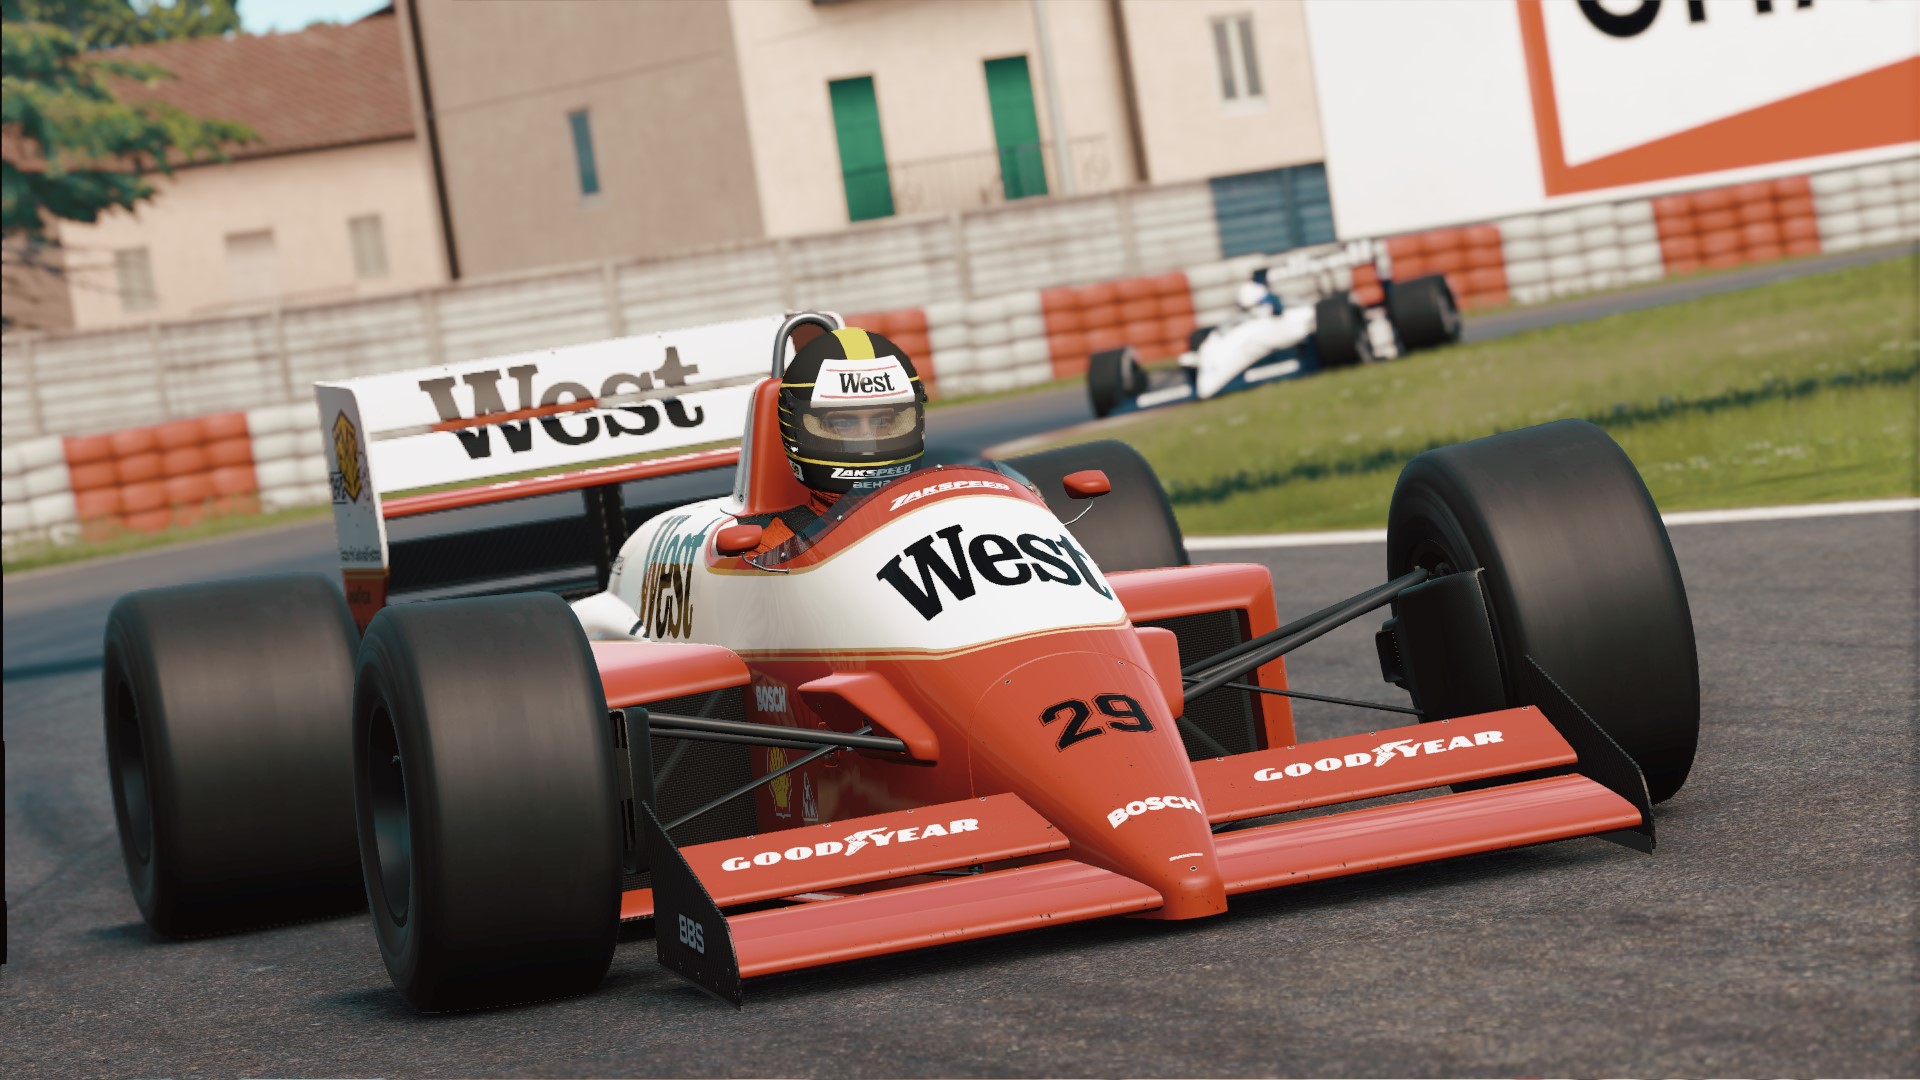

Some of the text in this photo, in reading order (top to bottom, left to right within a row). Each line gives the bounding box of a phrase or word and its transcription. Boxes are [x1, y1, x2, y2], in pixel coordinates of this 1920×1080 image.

[419, 346, 704, 460] West
[839, 372, 895, 393] West
[830, 463, 912, 480] ZAKSPEED
[889, 480, 1012, 512] ZAKSPEED
[876, 524, 1114, 621] West
[755, 685, 787, 713] BOSCH
[1038, 694, 1154, 752] 29
[1253, 730, 1505, 782] GOODYEAR
[1106, 795, 1203, 830] BOSCH
[720, 817, 980, 872] GOODYEAR
[678, 914, 706, 955] BBS
